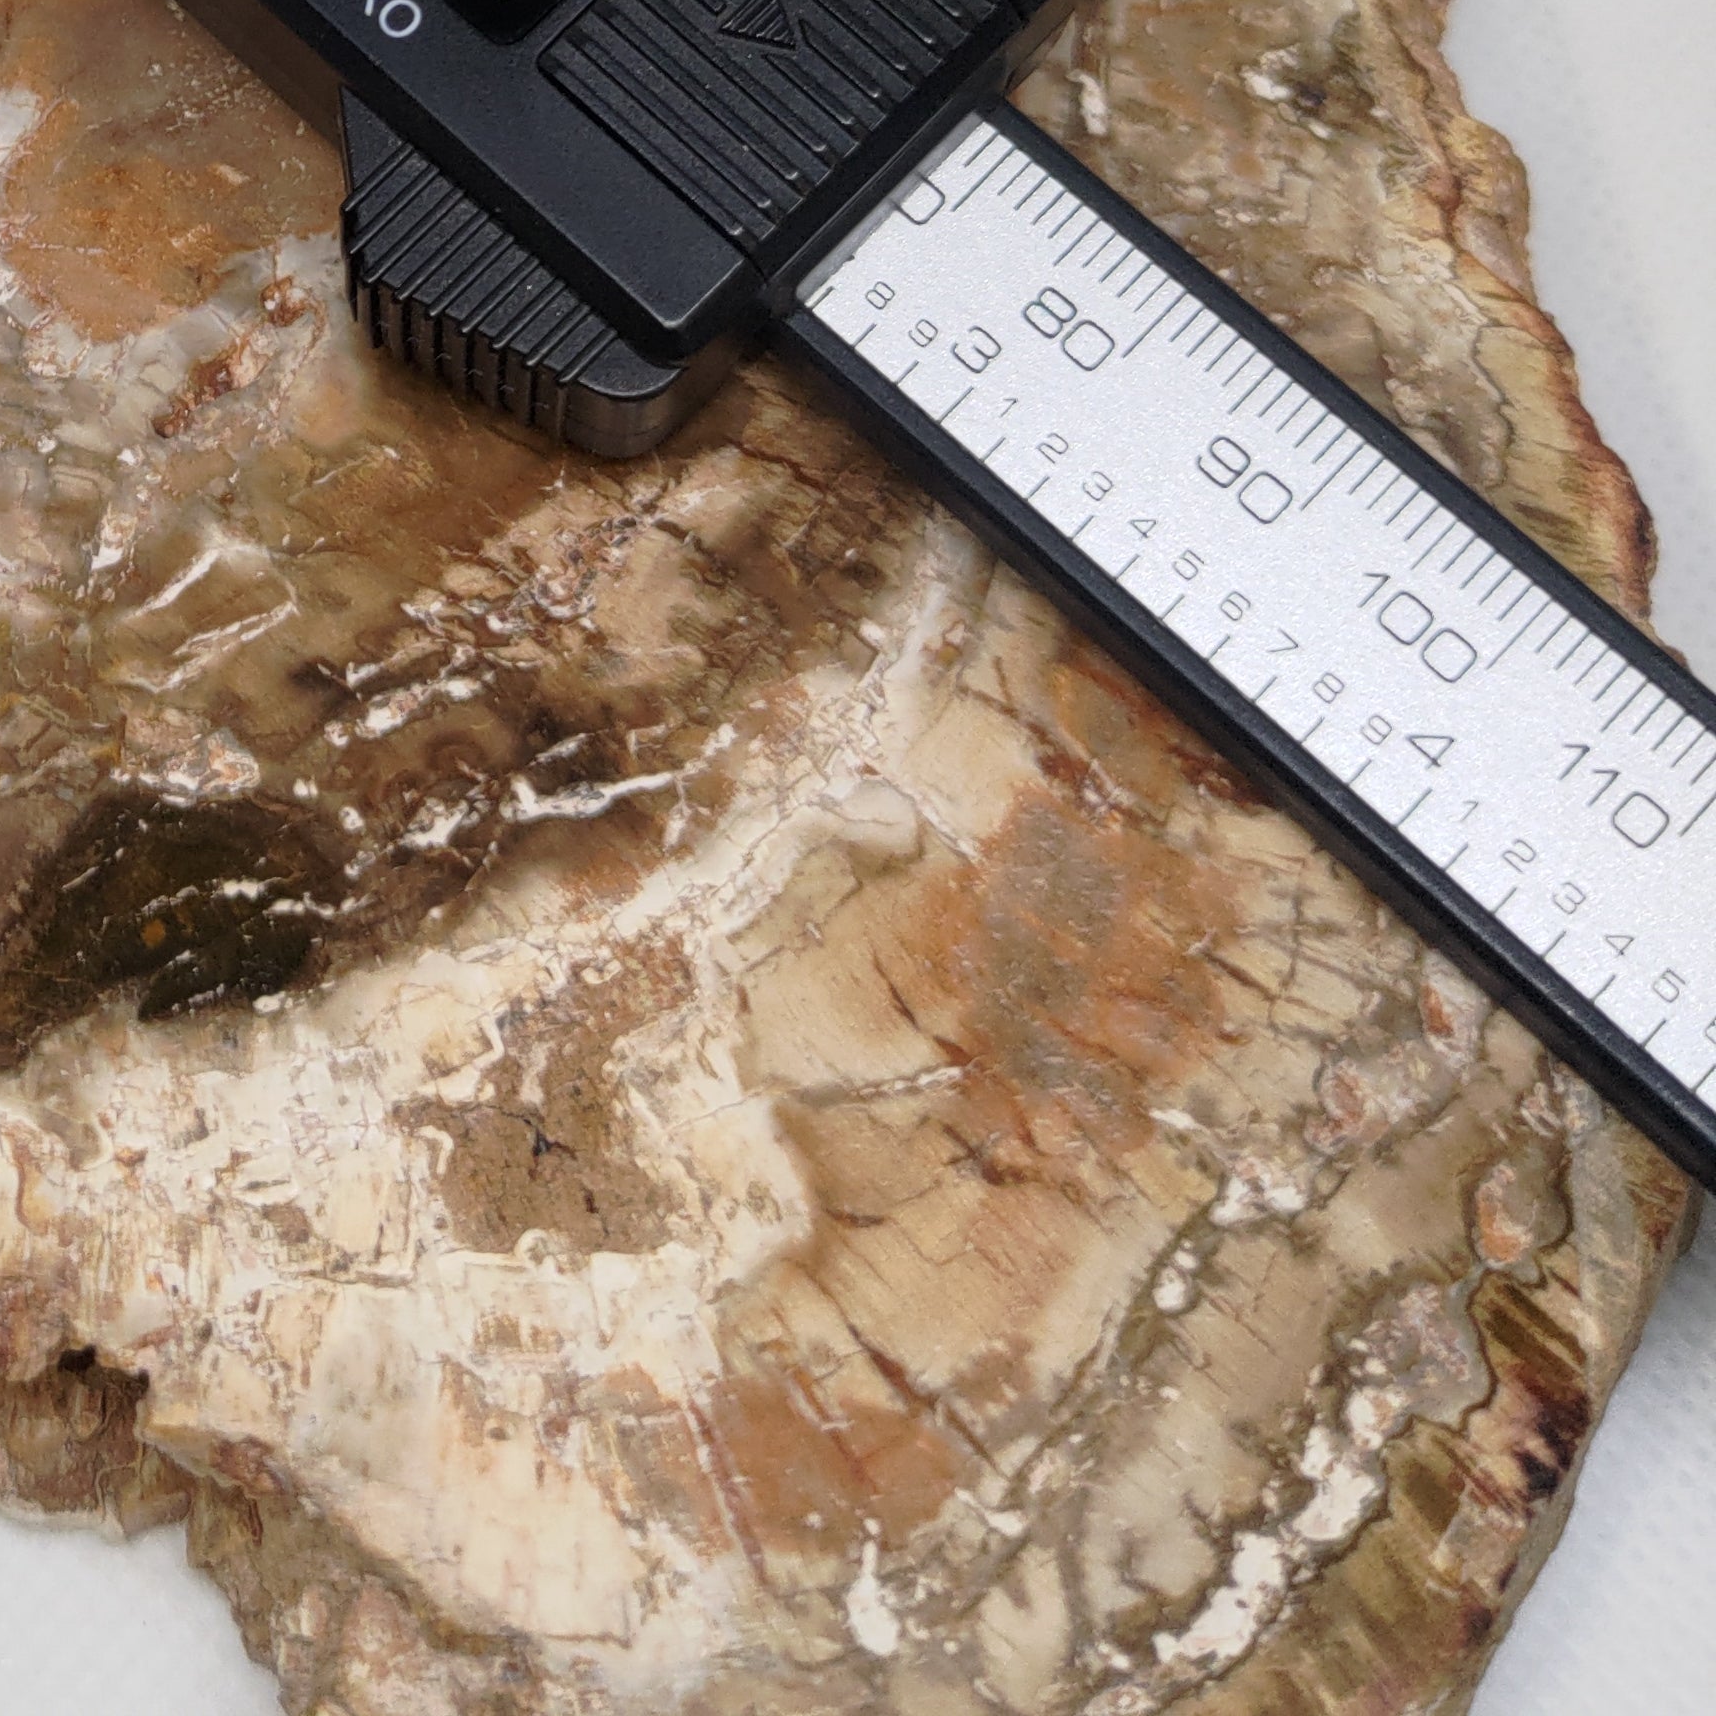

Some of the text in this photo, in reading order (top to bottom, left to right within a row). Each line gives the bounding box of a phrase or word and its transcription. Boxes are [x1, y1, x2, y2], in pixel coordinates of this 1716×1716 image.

[865, 281, 1686, 1004] 8 9 3 1 2 3 4 5 6 7 8 9 4 1 2 3 4 5
[1021, 285, 1116, 372] 80
[1196, 435, 1294, 525] 90
[1358, 571, 1479, 684] 100
[1558, 742, 1671, 850] 110
